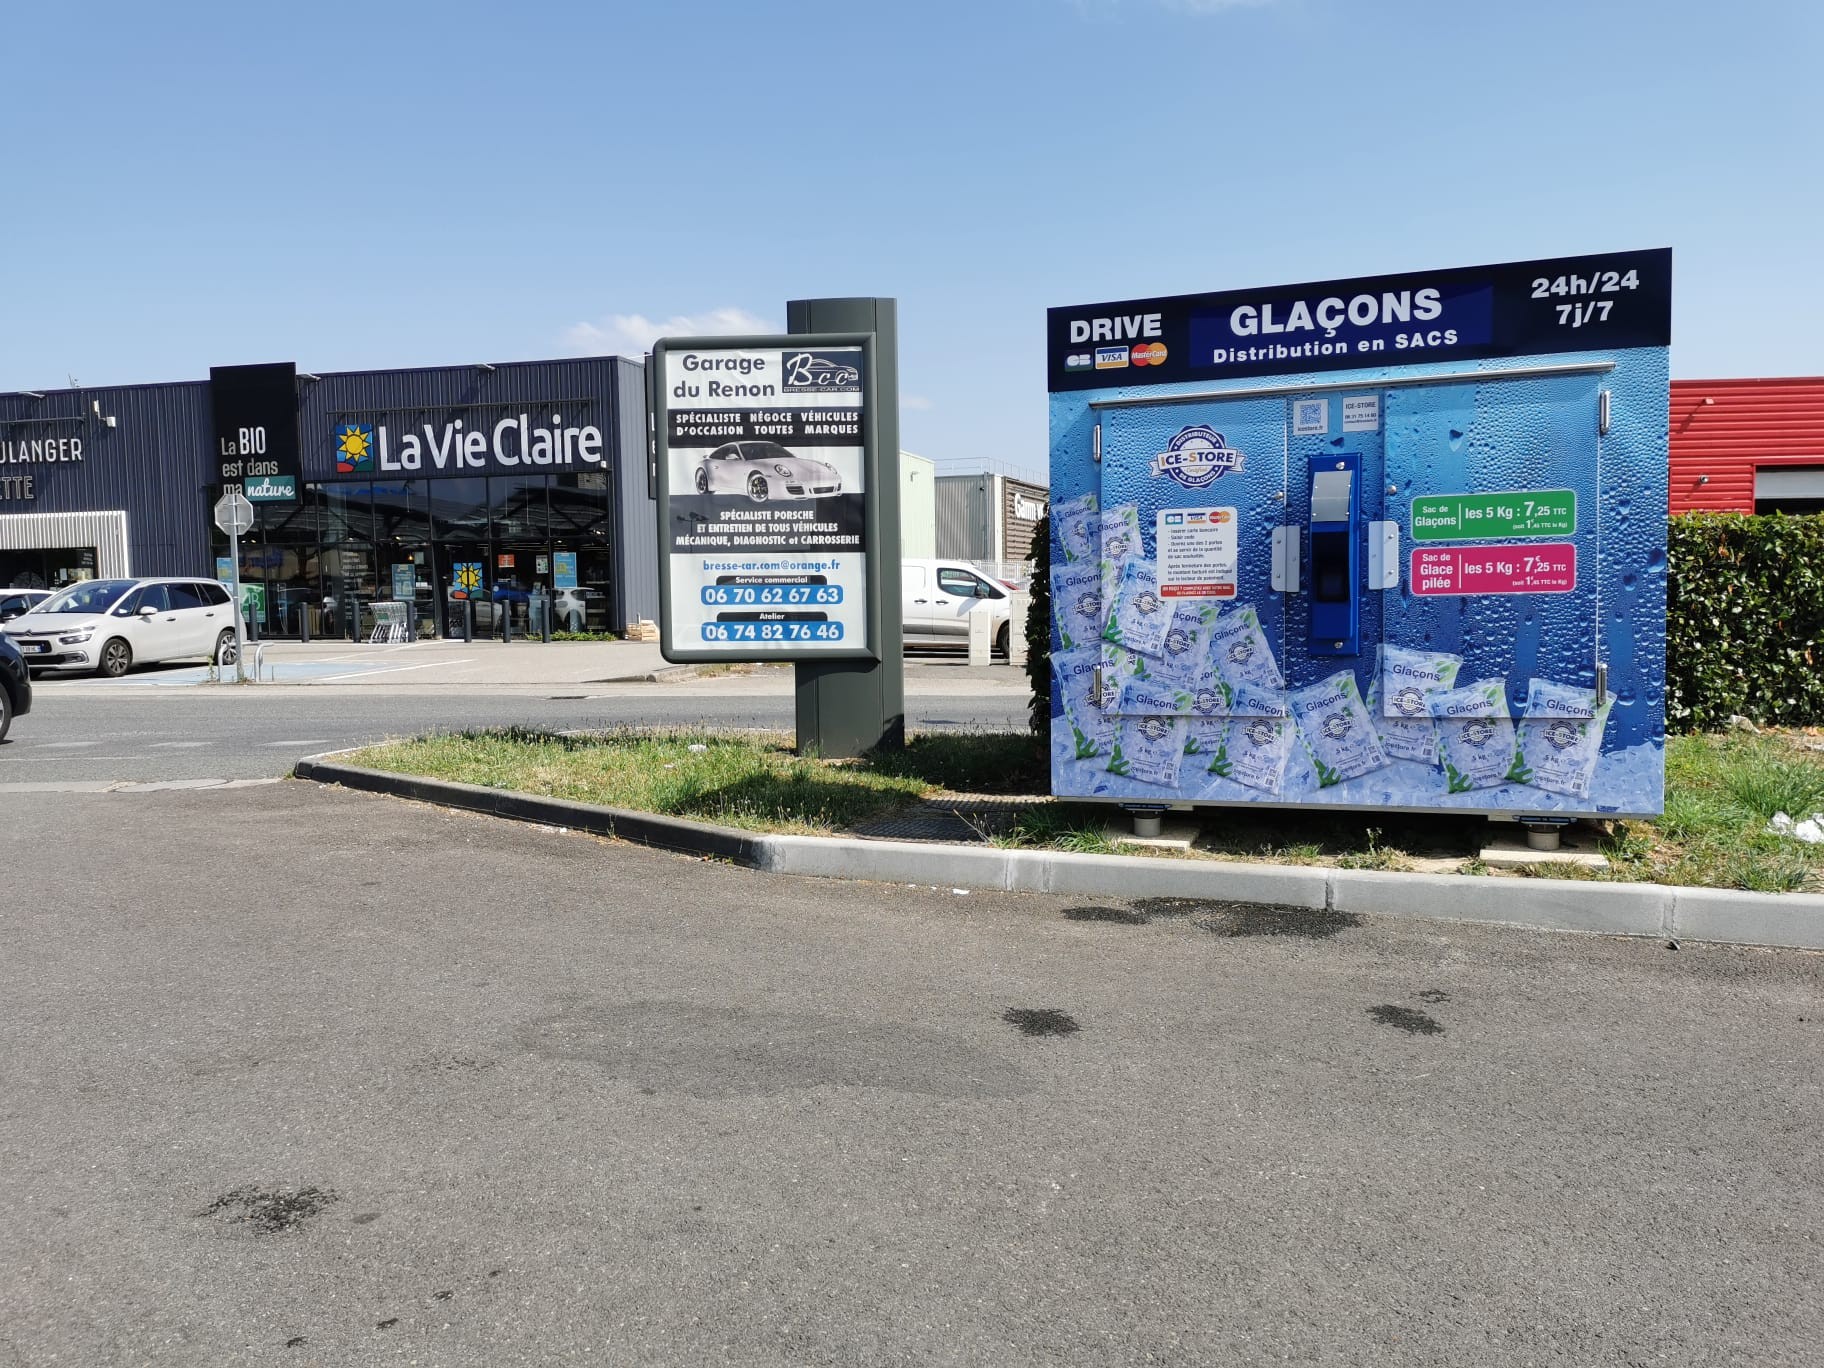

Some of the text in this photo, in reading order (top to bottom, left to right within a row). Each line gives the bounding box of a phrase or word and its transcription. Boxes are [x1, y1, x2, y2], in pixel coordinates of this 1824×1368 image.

[1531, 269, 1640, 299] 24h/24
[1230, 288, 1443, 337] GLAÇONS
[1556, 300, 1614, 328] 7j/7
[1070, 313, 1162, 343] DRIVE
[1213, 329, 1459, 364] Distribution en SACS
[682, 354, 766, 375] Garage
[1101, 353, 1123, 362] VISA
[673, 380, 775, 398] du Renon
[675, 410, 859, 424] SPÉCIALISTE NÉGOCE VÉHICULES
[754, 425, 794, 435] TOUTES
[804, 424, 859, 434] MARQUES
[221, 426, 267, 455] La BIO
[493, 413, 602, 466] Claire
[1161, 452, 1234, 466] ICE-STORE
[222, 458, 279, 477] est dans
[0, 475, 34, 500] TTE
[247, 477, 294, 497] nature
[720, 509, 814, 521] SPÉCIALISTE PORSCHE
[1465, 508, 1482, 519] les
[1486, 507, 1493, 518] 5
[1497, 506, 1513, 519] Kg
[697, 521, 838, 533] ET ENTRETIEN DE TOUS VÉHICULES
[1415, 517, 1456, 528] Glaçons
[675, 534, 731, 547] MÉCANIQUE,
[733, 535, 786, 545] DIAGNOSTIC
[800, 535, 860, 545] CARROSSERIE
[1440, 553, 1451, 561] de
[703, 559, 840, 572] bresse-car.com@orange.fr
[1420, 564, 1453, 575] Glace
[1465, 563, 1482, 574] les
[1486, 563, 1493, 573] 5
[1497, 562, 1513, 575] Kg
[735, 576, 808, 584] Service commercial
[1137, 571, 1157, 584] Glaç
[1422, 577, 1451, 591] pilée
[705, 588, 839, 603] 06 70 62 67 63
[1173, 611, 1203, 625] açons
[706, 625, 839, 639] 06 74 82 76 46
[1214, 623, 1250, 640] Glaçons
[1393, 664, 1441, 681] Glaçons
[1136, 694, 1178, 711] Glaçons
[1248, 698, 1290, 718] Glaçons
[1306, 693, 1347, 712] Glaçons
[1447, 701, 1493, 716] Glaçons
[1546, 699, 1596, 718] Glaçons
